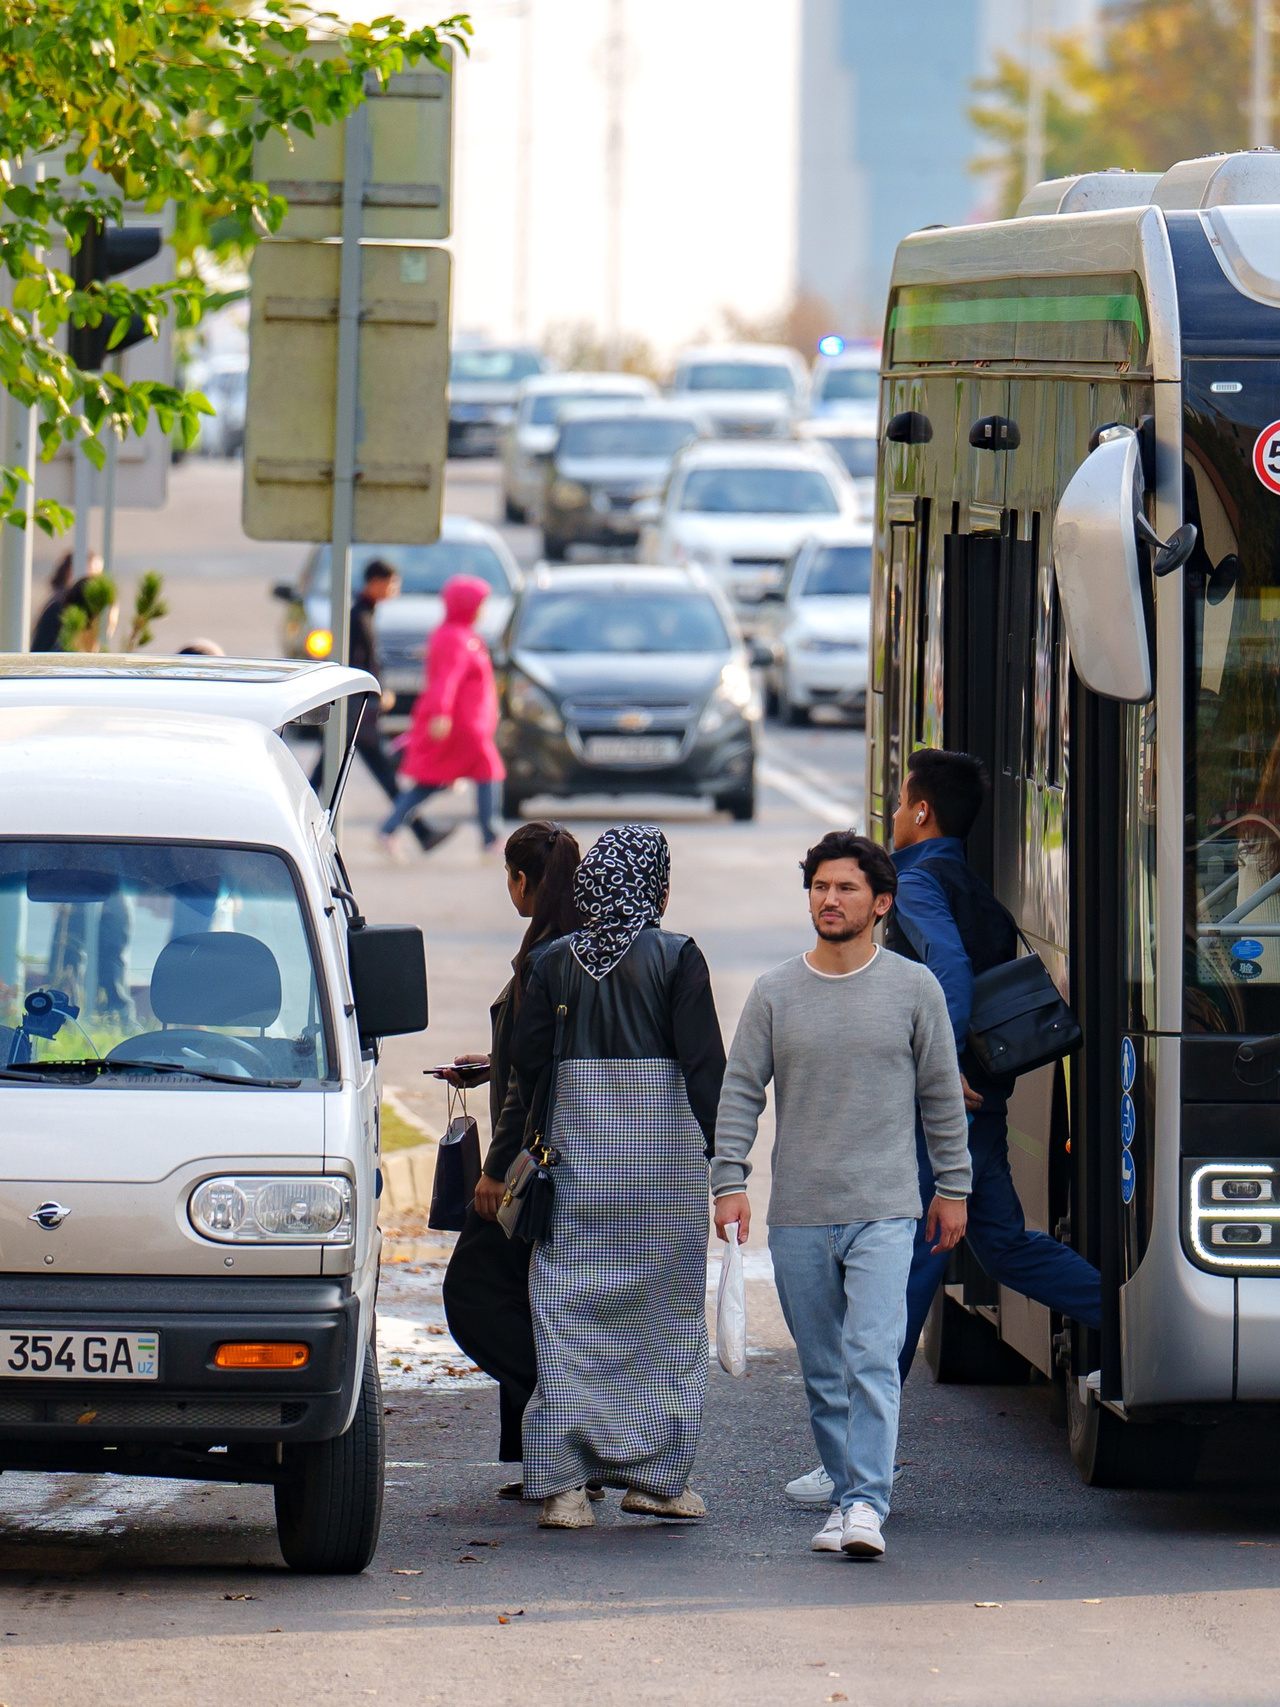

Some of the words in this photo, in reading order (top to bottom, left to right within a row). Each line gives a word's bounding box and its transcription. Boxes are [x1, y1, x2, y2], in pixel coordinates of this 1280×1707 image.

[8, 1335, 76, 1373] 354
[83, 1337, 134, 1374] GA
[137, 1361, 155, 1374] UZ
